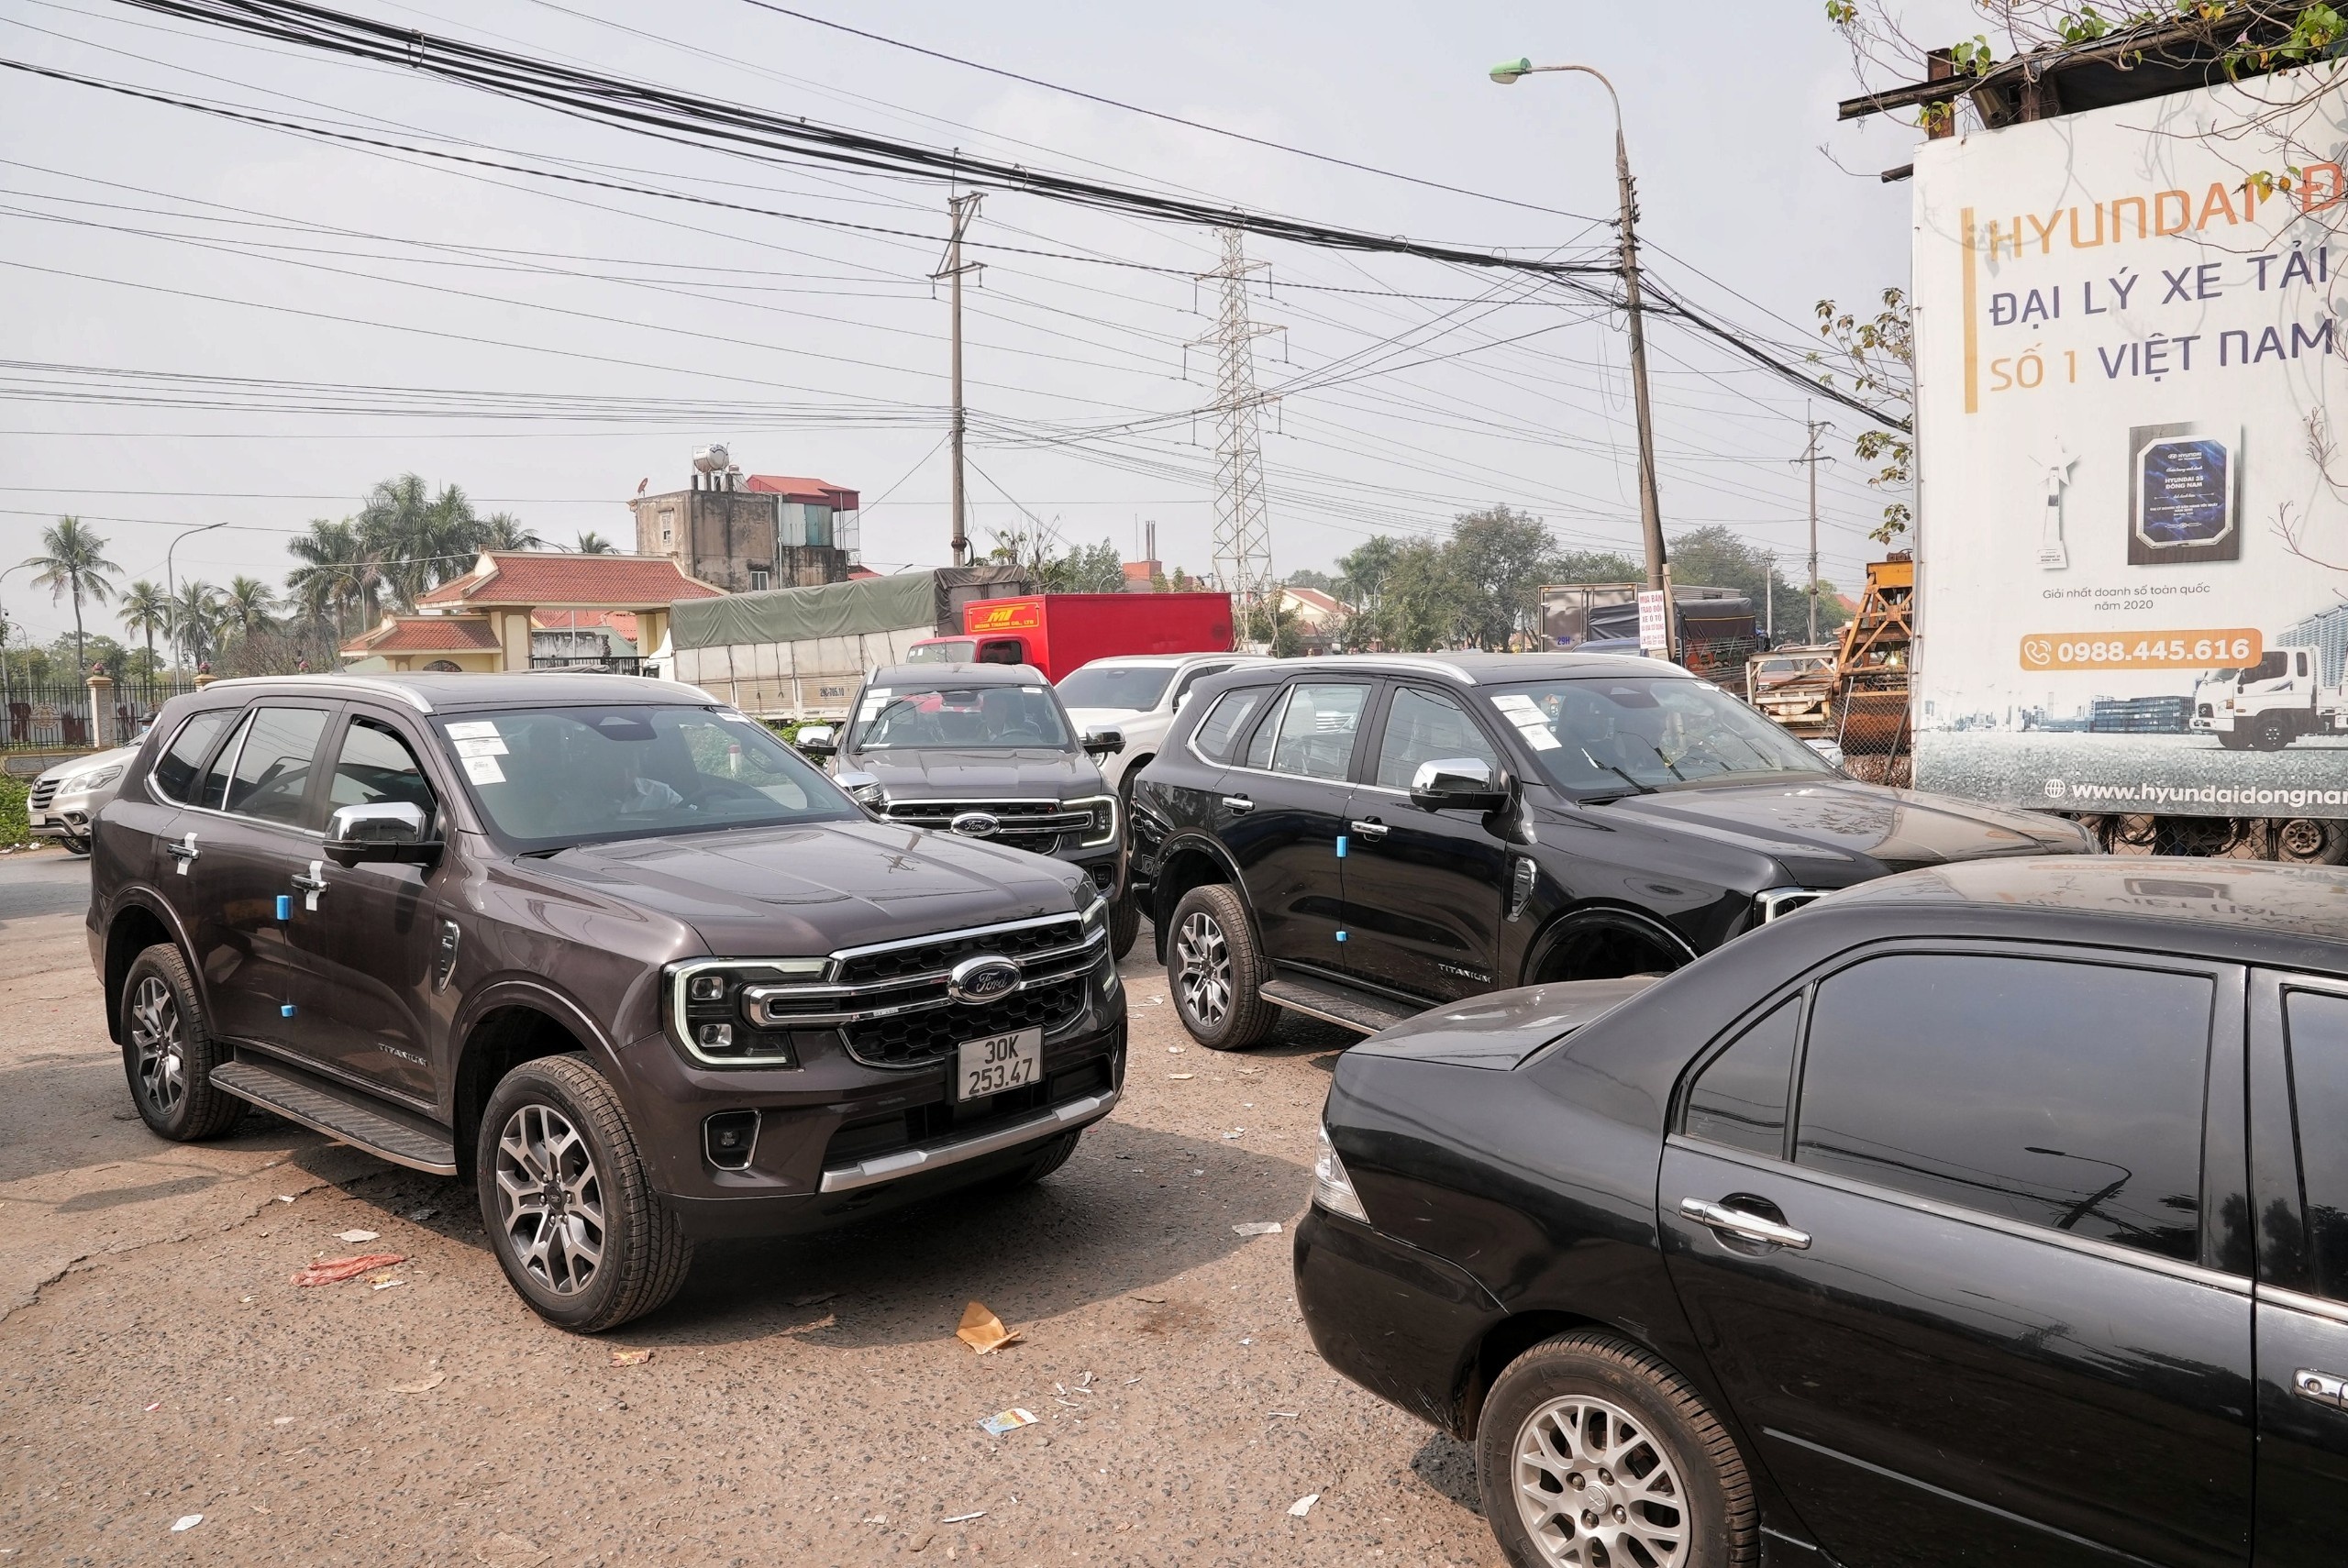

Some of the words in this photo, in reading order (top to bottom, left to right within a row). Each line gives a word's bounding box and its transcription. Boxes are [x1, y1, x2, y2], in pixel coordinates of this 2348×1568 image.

[1989, 176, 2254, 261] HYUNDAI
[1989, 286, 2060, 329] ĐẠI
[2084, 267, 2139, 315] LÝ
[2162, 262, 2222, 304] XE
[2247, 240, 2328, 293] TẢI
[1990, 343, 2043, 392] SỐ
[2064, 350, 2076, 383] 1
[2098, 333, 2200, 382] VIỆT
[2220, 318, 2333, 367] NAM
[2043, 587, 2065, 599] Giải
[2066, 586, 2092, 598] nhất
[2094, 587, 2131, 597] doanh
[2133, 584, 2148, 595] số
[2150, 584, 2177, 595] toàn
[2179, 581, 2210, 596] quốc
[2094, 600, 2121, 611] năm
[2123, 600, 2154, 610] 2020
[2057, 638, 2250, 663] 0988.445.616
[976, 970, 1008, 993] Ford
[1438, 963, 1492, 984] TITANIUM
[378, 1043, 427, 1068] TITANIUM
[984, 1034, 1020, 1065] 30K
[969, 1057, 1034, 1095] 253.47
